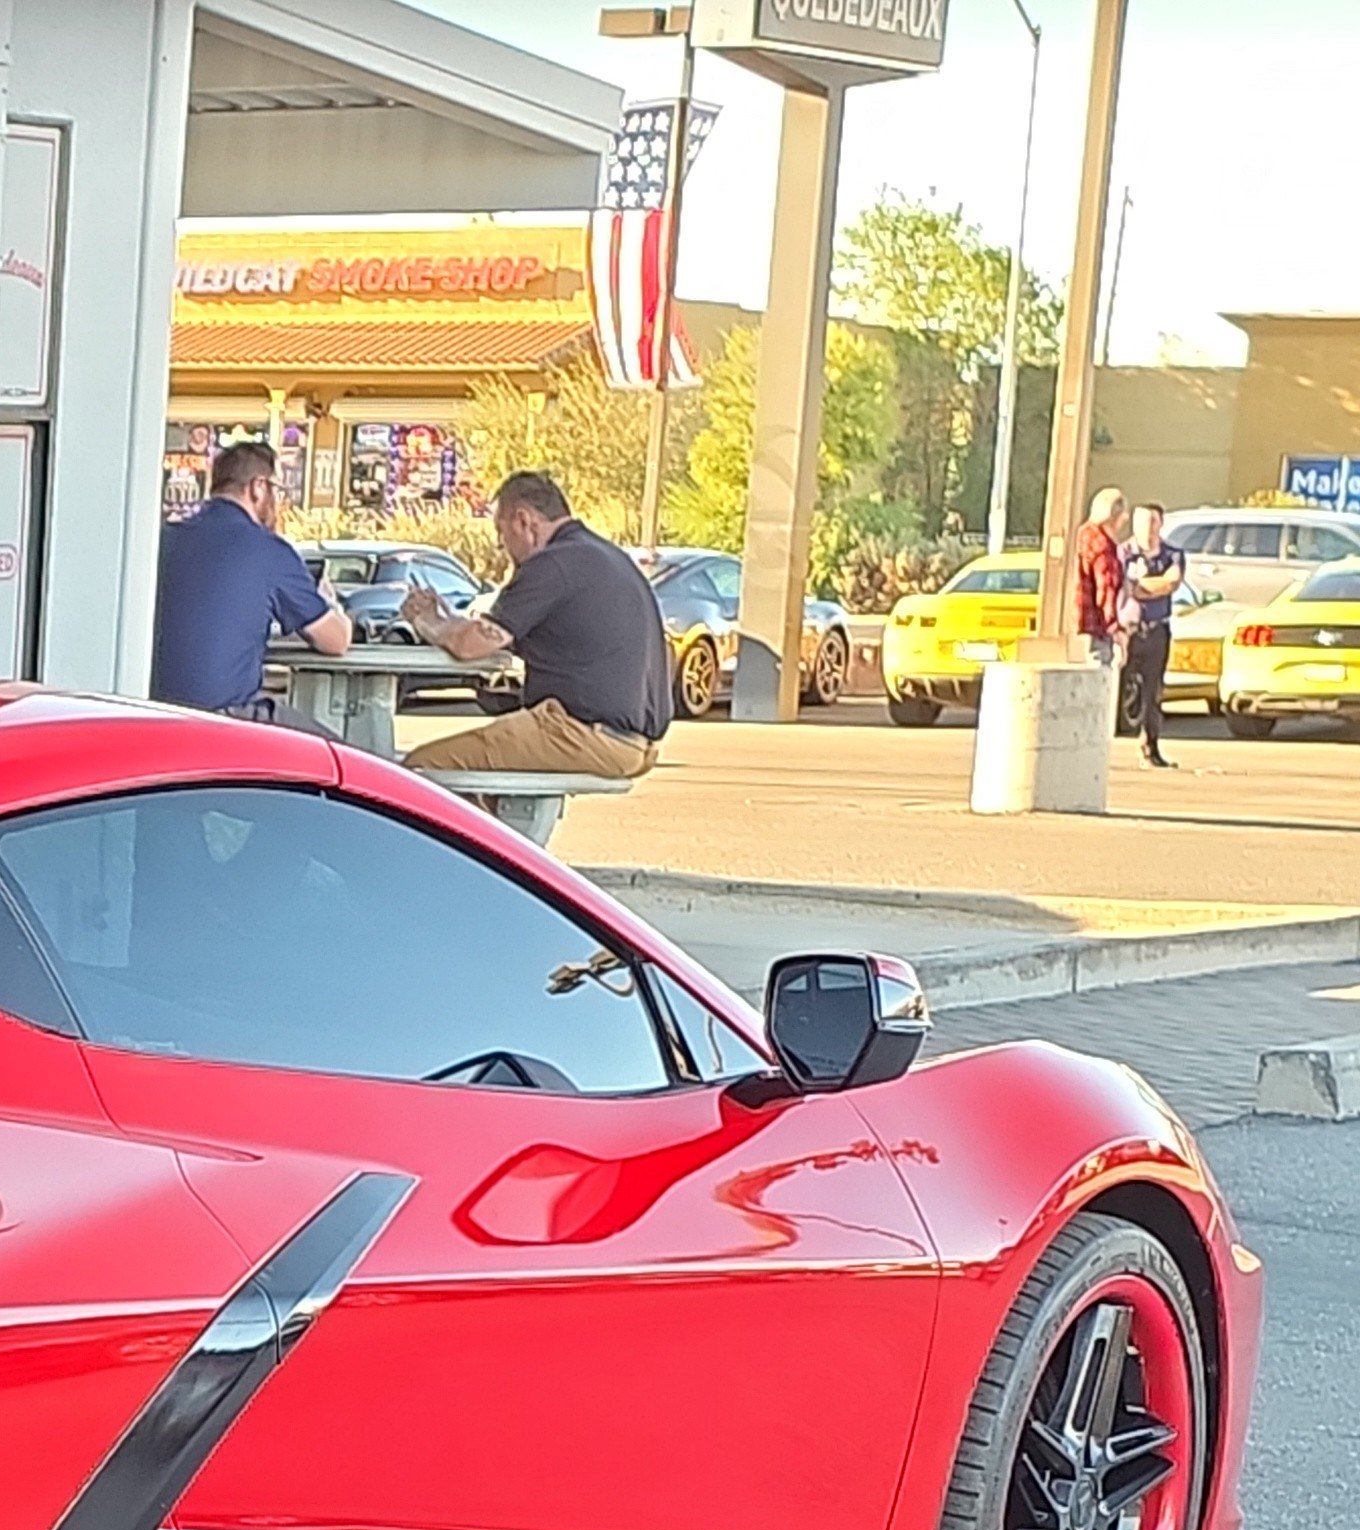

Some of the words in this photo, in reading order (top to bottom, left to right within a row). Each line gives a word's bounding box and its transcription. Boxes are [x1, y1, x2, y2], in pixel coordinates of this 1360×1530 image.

[175, 262, 298, 292] ILDCAT
[308, 257, 433, 292] SMOKE
[439, 256, 542, 292] SHOP
